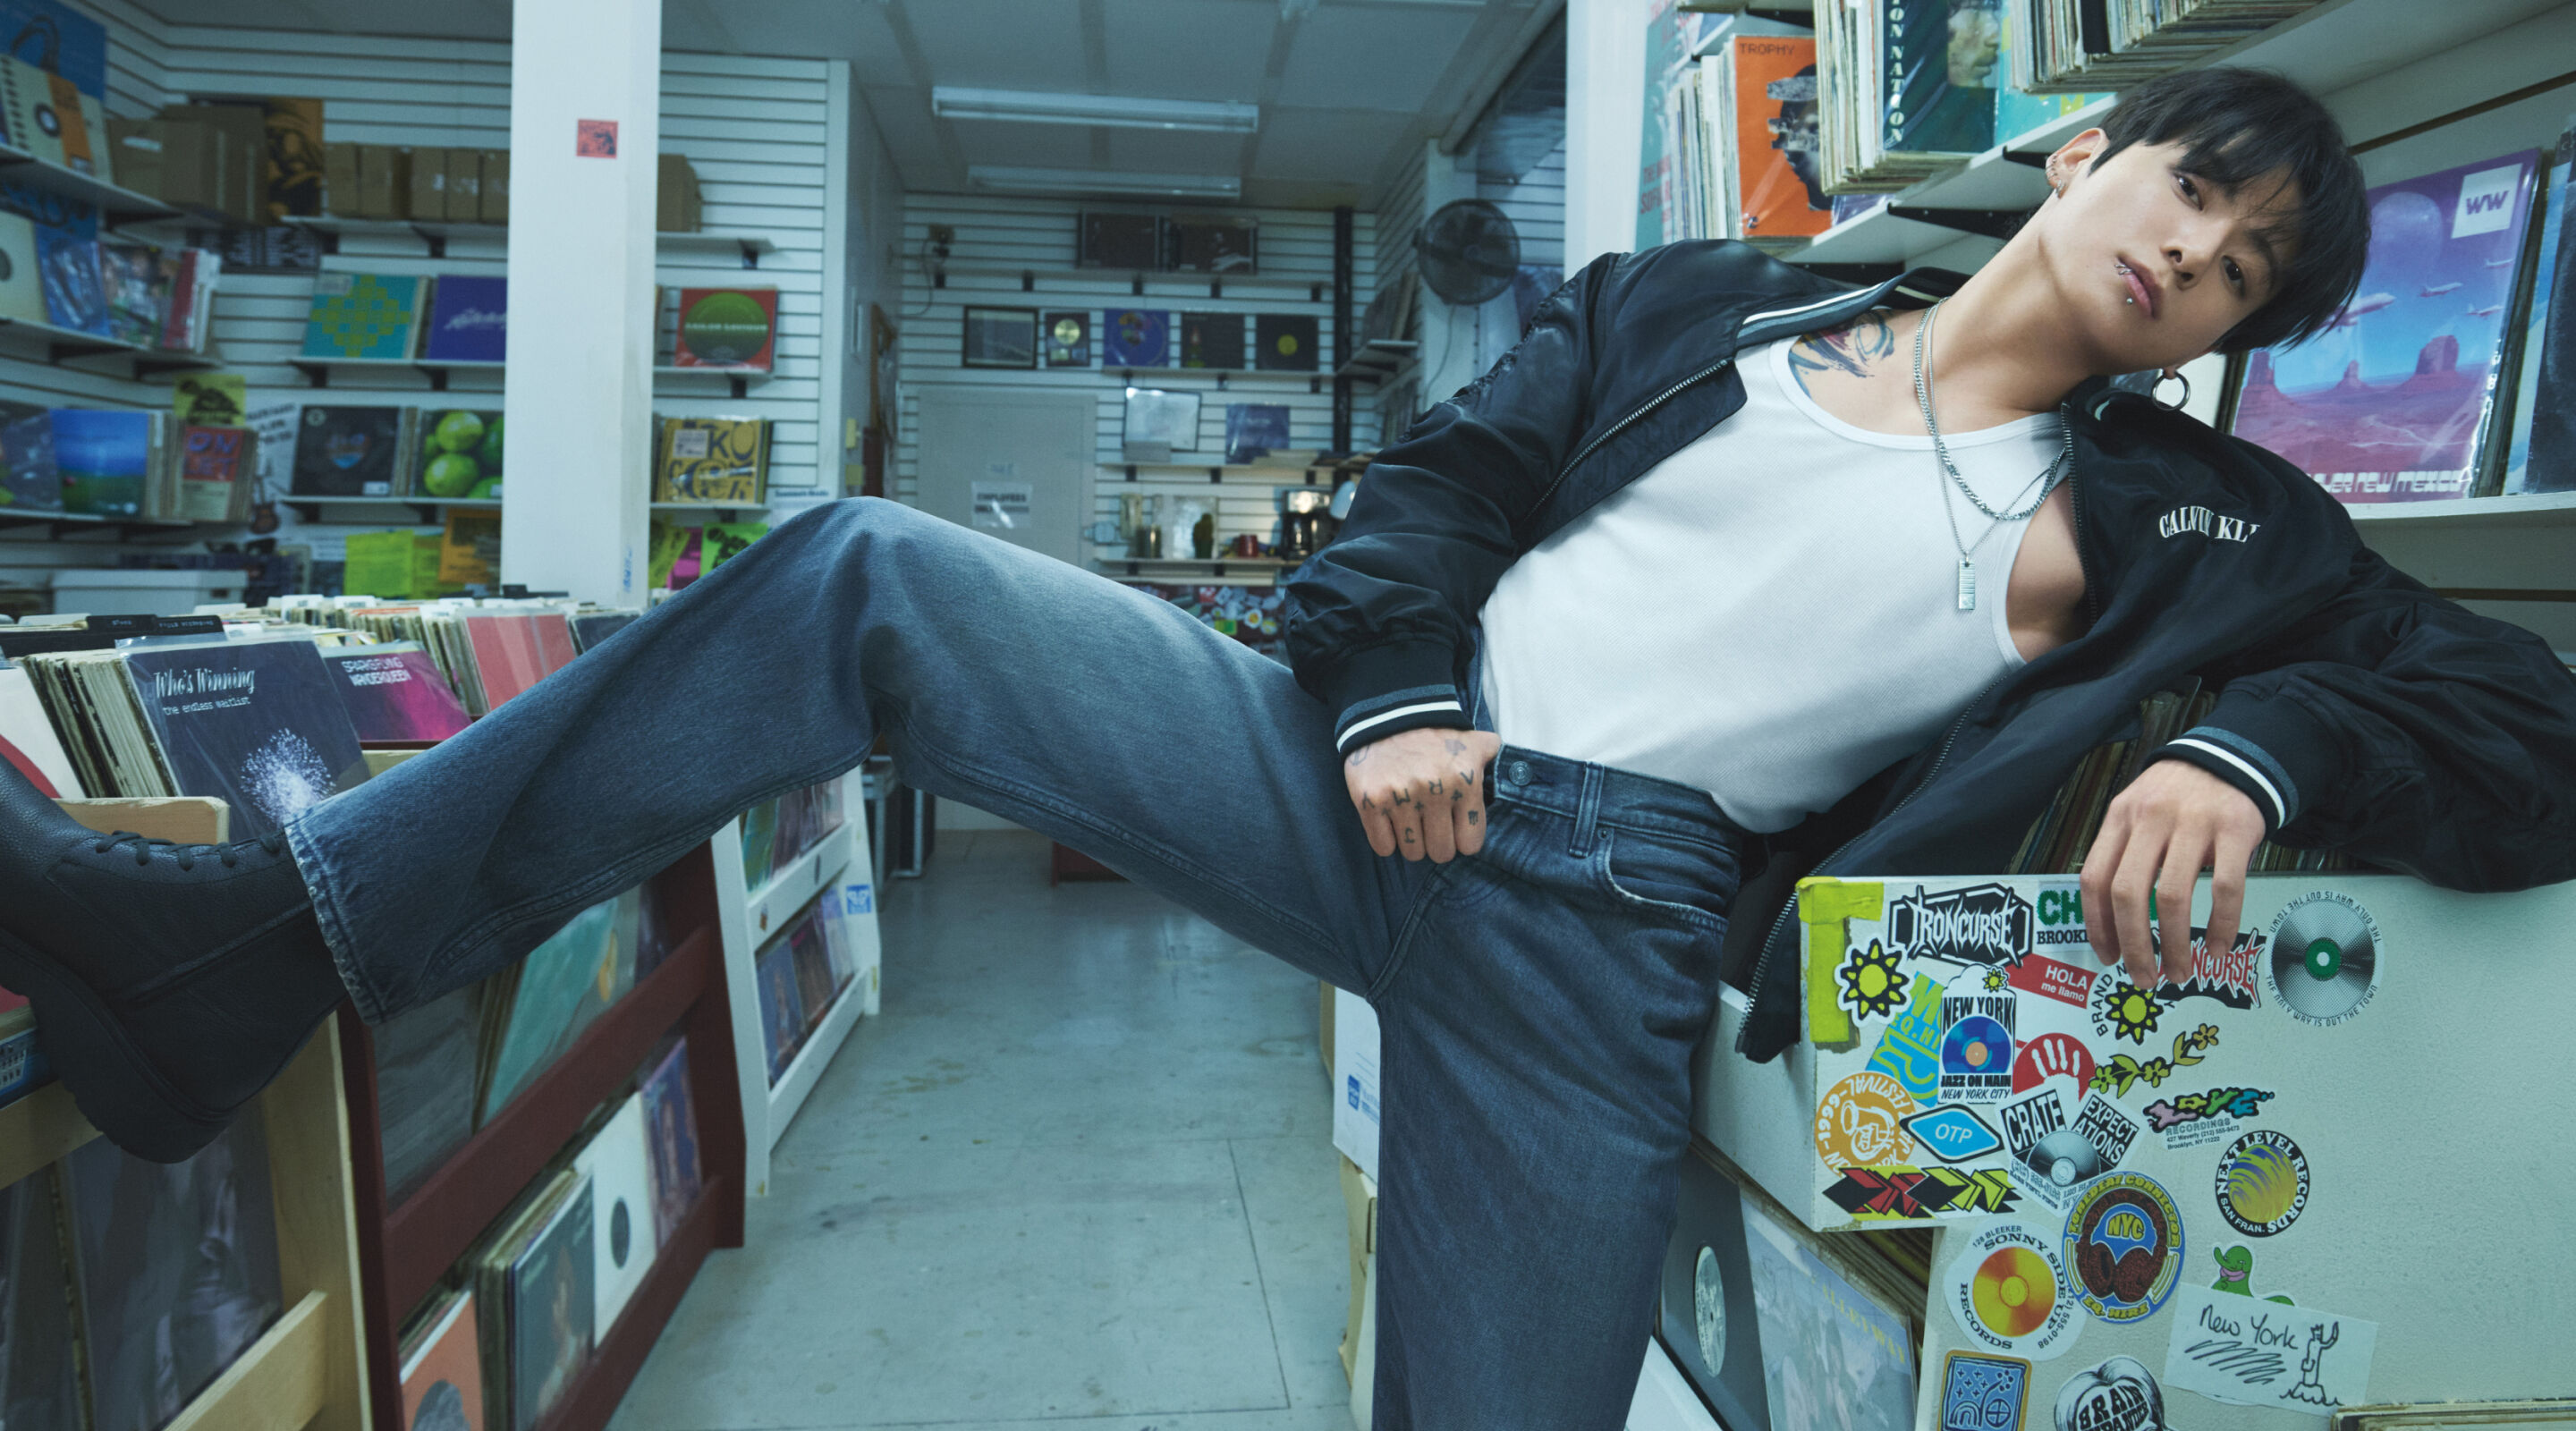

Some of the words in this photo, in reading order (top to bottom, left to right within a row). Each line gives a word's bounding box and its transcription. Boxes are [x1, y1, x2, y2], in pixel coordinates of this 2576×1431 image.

[1739, 43, 1795, 56] TROPHY
[1888, 45, 1905, 142] NATION
[2393, 470, 2463, 493] MEXICO
[2159, 505, 2215, 538] CALVIN
[153, 668, 194, 699] Who's
[195, 666, 255, 694] Winning
[163, 707, 179, 716] the
[182, 702, 214, 713] endless
[215, 697, 250, 708] waitlist
[2287, 896, 2304, 910] THE
[2306, 891, 2321, 902] OUT
[2335, 893, 2354, 907] WAY
[1904, 885, 2021, 968] IRONCURSE
[2269, 909, 2289, 933] TOWN
[2370, 923, 2382, 943] THE
[2045, 965, 2089, 991] HOLA
[2040, 982, 2057, 994] me
[2058, 986, 2086, 1002] llamo
[2091, 974, 2114, 1037] BRAND
[2266, 974, 2277, 993] THE
[2292, 1011, 2312, 1024] WAY
[2314, 1018, 2323, 1027] IS
[2326, 1016, 2343, 1027] OUT
[2343, 1007, 2360, 1021] THE
[2360, 984, 2378, 1009] TOWN
[1943, 996, 1974, 1037] NEW
[1976, 996, 2014, 1037] YORK
[1845, 1074, 1911, 1110] FESTIVAL
[1940, 1074, 1966, 1088] JAZZ
[1967, 1074, 1983, 1088] ON
[1984, 1074, 2012, 1088] MAIN
[1940, 1088, 1963, 1099] NEW
[1965, 1088, 1990, 1099] YORK
[1989, 1088, 2011, 1099] CITY
[1935, 1123, 1973, 1144] OTP
[2004, 1091, 2066, 1151] CRATE
[2083, 1097, 2139, 1144] EXPECT
[2165, 1117, 2231, 1136] RECORDINGS
[2072, 1117, 2125, 1164] ATIONS
[2167, 1142, 2192, 1150] Brooklyn,
[2205, 1136, 2220, 1144] 11222
[2178, 1131, 2199, 1142] Waverly
[2200, 1129, 2215, 1139] (212)
[2244, 1131, 2298, 1156] LEVEL
[2216, 1143, 2242, 1195] NEXT
[2267, 1156, 2309, 1233] RECORDS
[2106, 1212, 2145, 1240] NYC
[2220, 1197, 2235, 1219] SAN
[2234, 1218, 2266, 1233] FRAN.
[1972, 1236, 1986, 1248] 128
[1986, 1225, 2022, 1239] BLEEKER
[1984, 1233, 2049, 1252] SONNY
[2046, 1252, 2066, 1299] SIDE
[1960, 1283, 2012, 1349] RECORDS
[2047, 1304, 2066, 1330] UP
[2199, 1304, 2241, 1336] New
[2250, 1313, 2299, 1350] York
[2038, 1312, 2071, 1349] 555-0198
[2079, 1384, 2146, 1430] BRAIN
